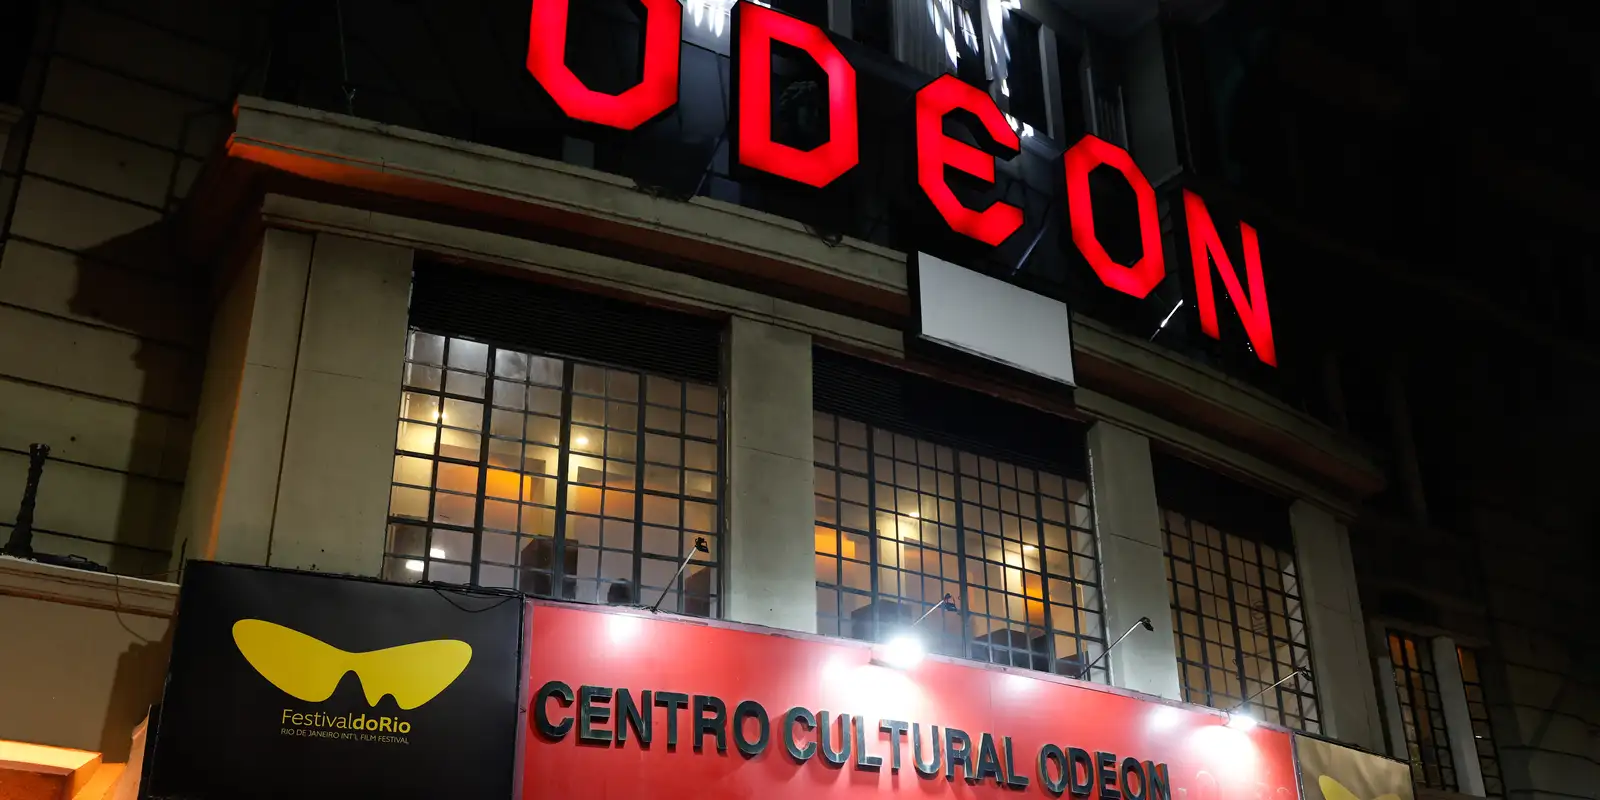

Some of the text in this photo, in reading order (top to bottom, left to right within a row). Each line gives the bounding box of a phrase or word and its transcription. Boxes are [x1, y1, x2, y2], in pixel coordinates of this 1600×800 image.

[526, 0, 1278, 368] ODEON
[280, 728, 295, 736] RIO
[296, 729, 307, 737] DE
[308, 730, 340, 739] JANEIRO
[360, 733, 377, 742] FILM
[377, 735, 410, 745] FESTIVAL
[533, 680, 1171, 800] CENTRO CULTURAL ODEON
